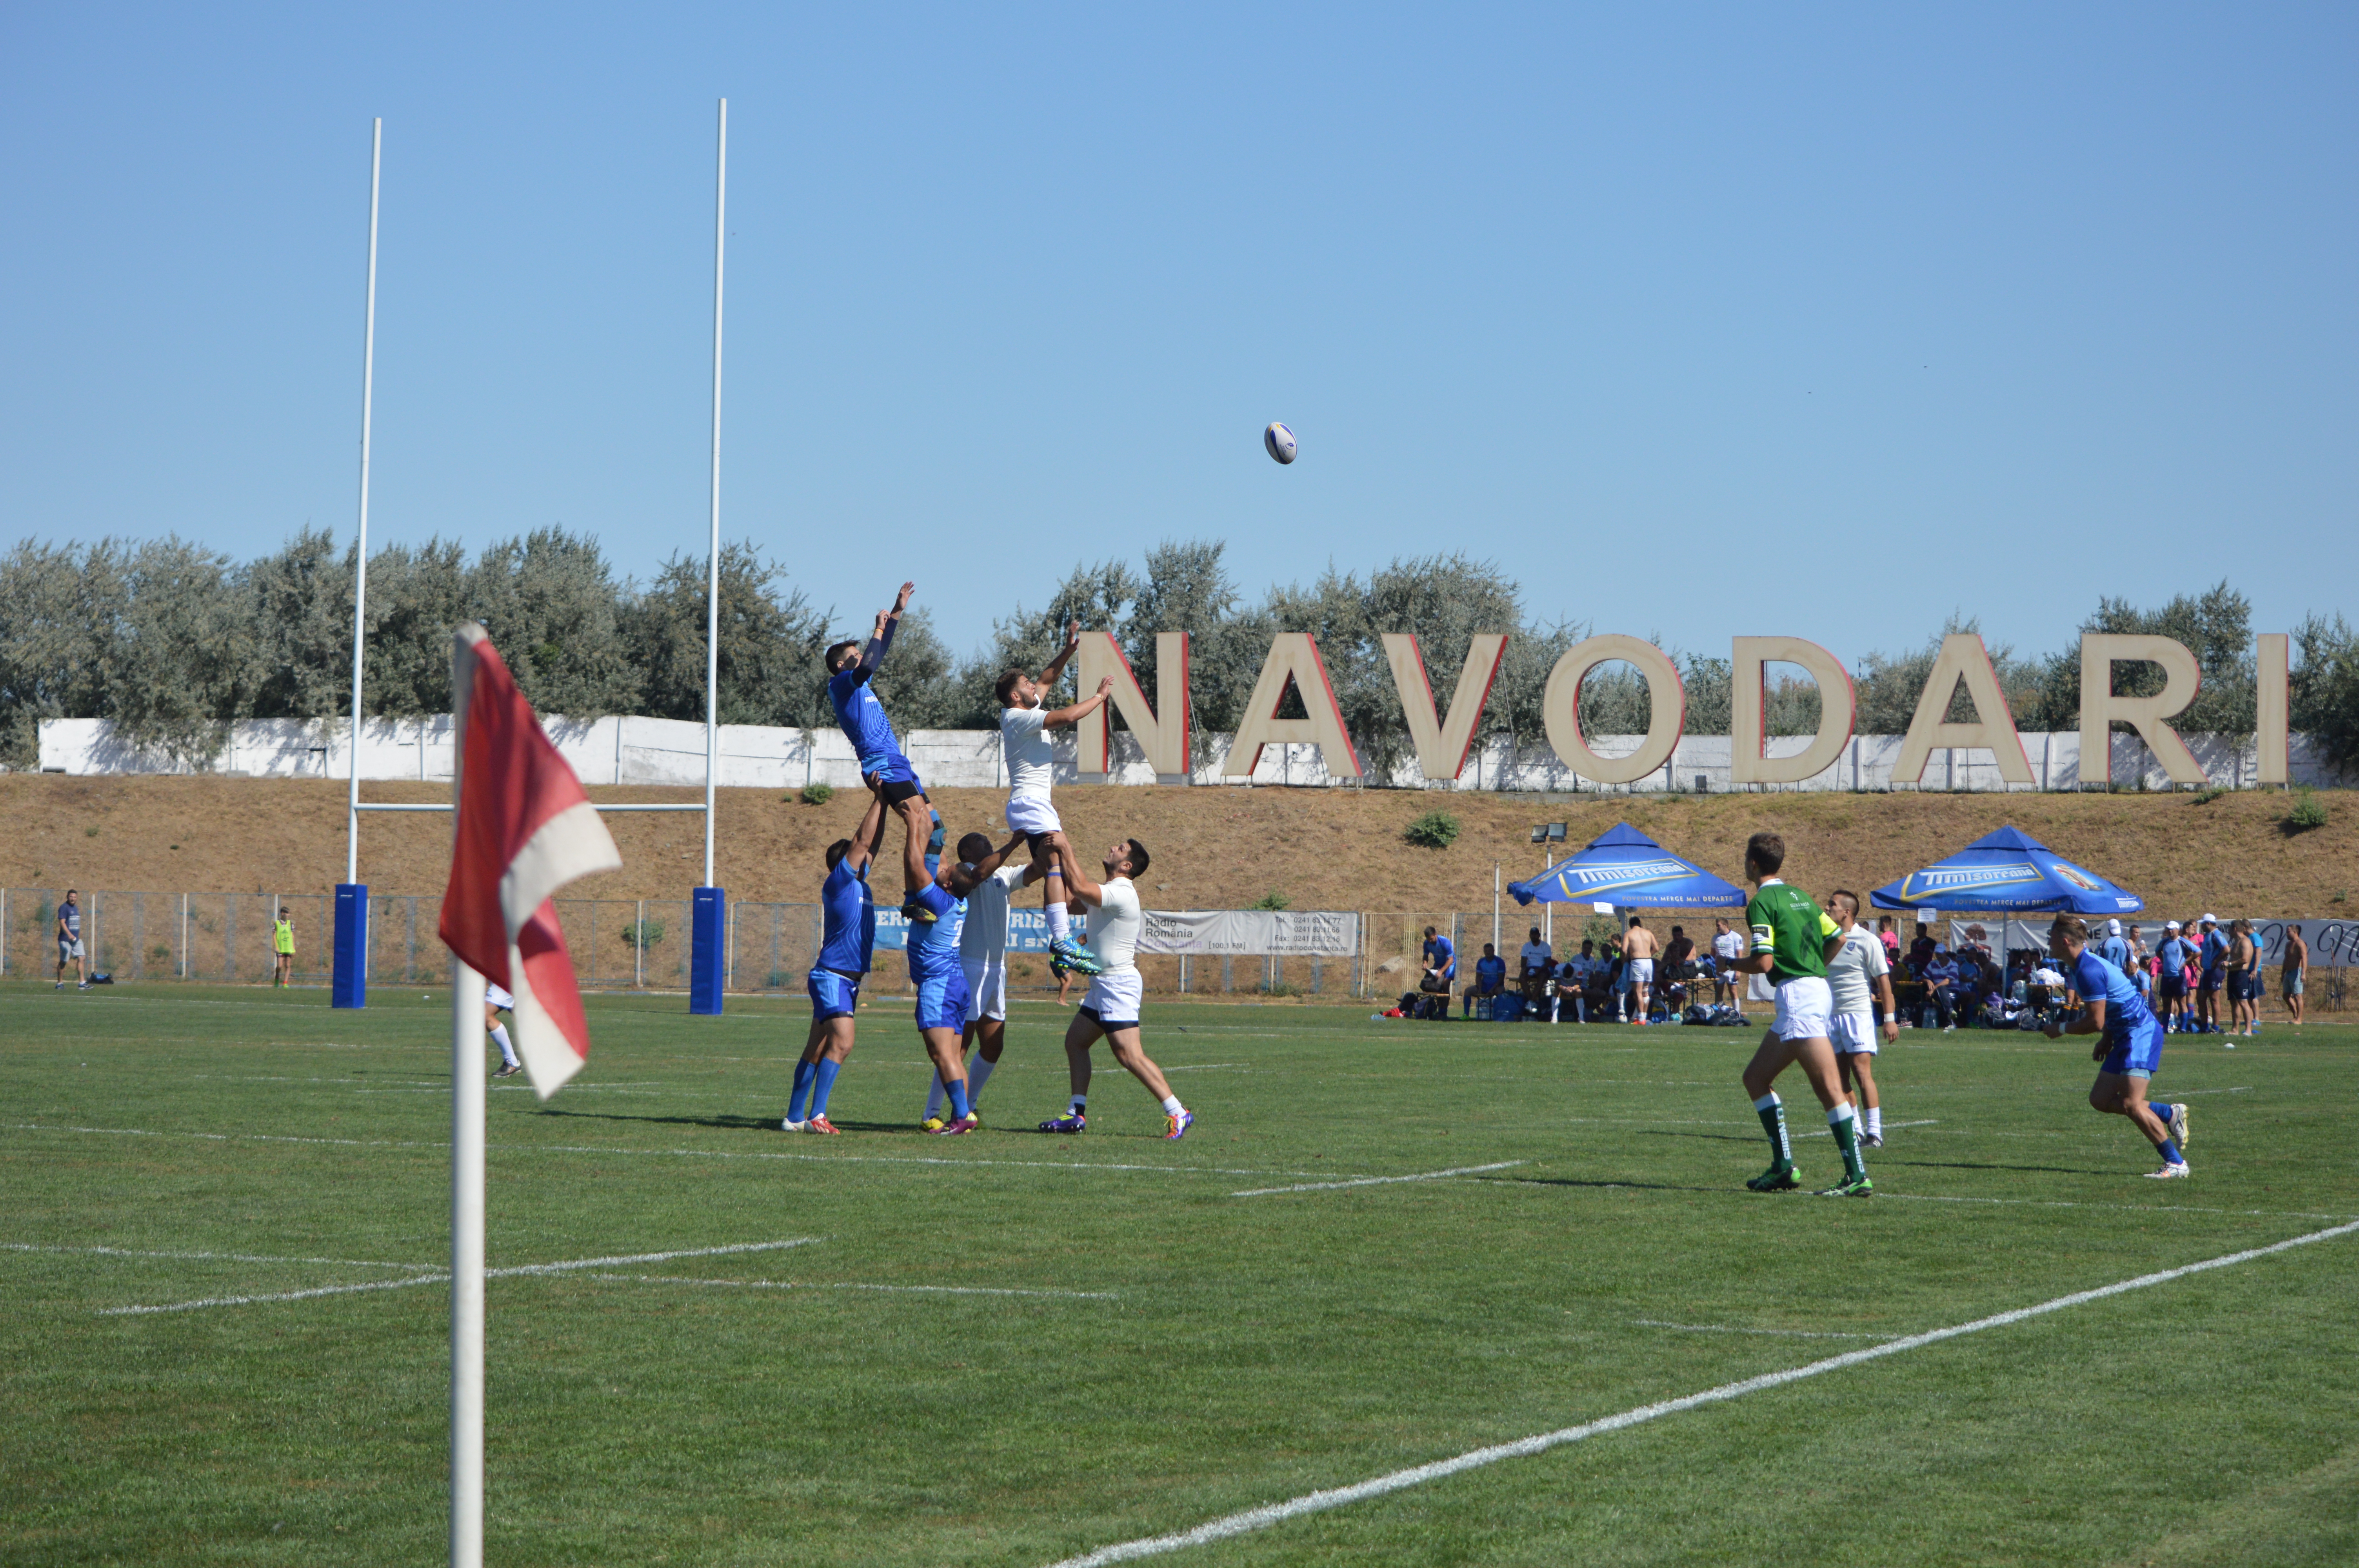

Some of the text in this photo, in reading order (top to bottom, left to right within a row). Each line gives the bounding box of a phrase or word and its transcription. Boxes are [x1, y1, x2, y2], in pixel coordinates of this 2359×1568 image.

[1078, 632, 2288, 784] NAVODARI
[1146, 918, 1177, 927] Radio
[951, 919, 963, 947] 2
[1145, 928, 1193, 937] România
[2112, 947, 2118, 958] 7
